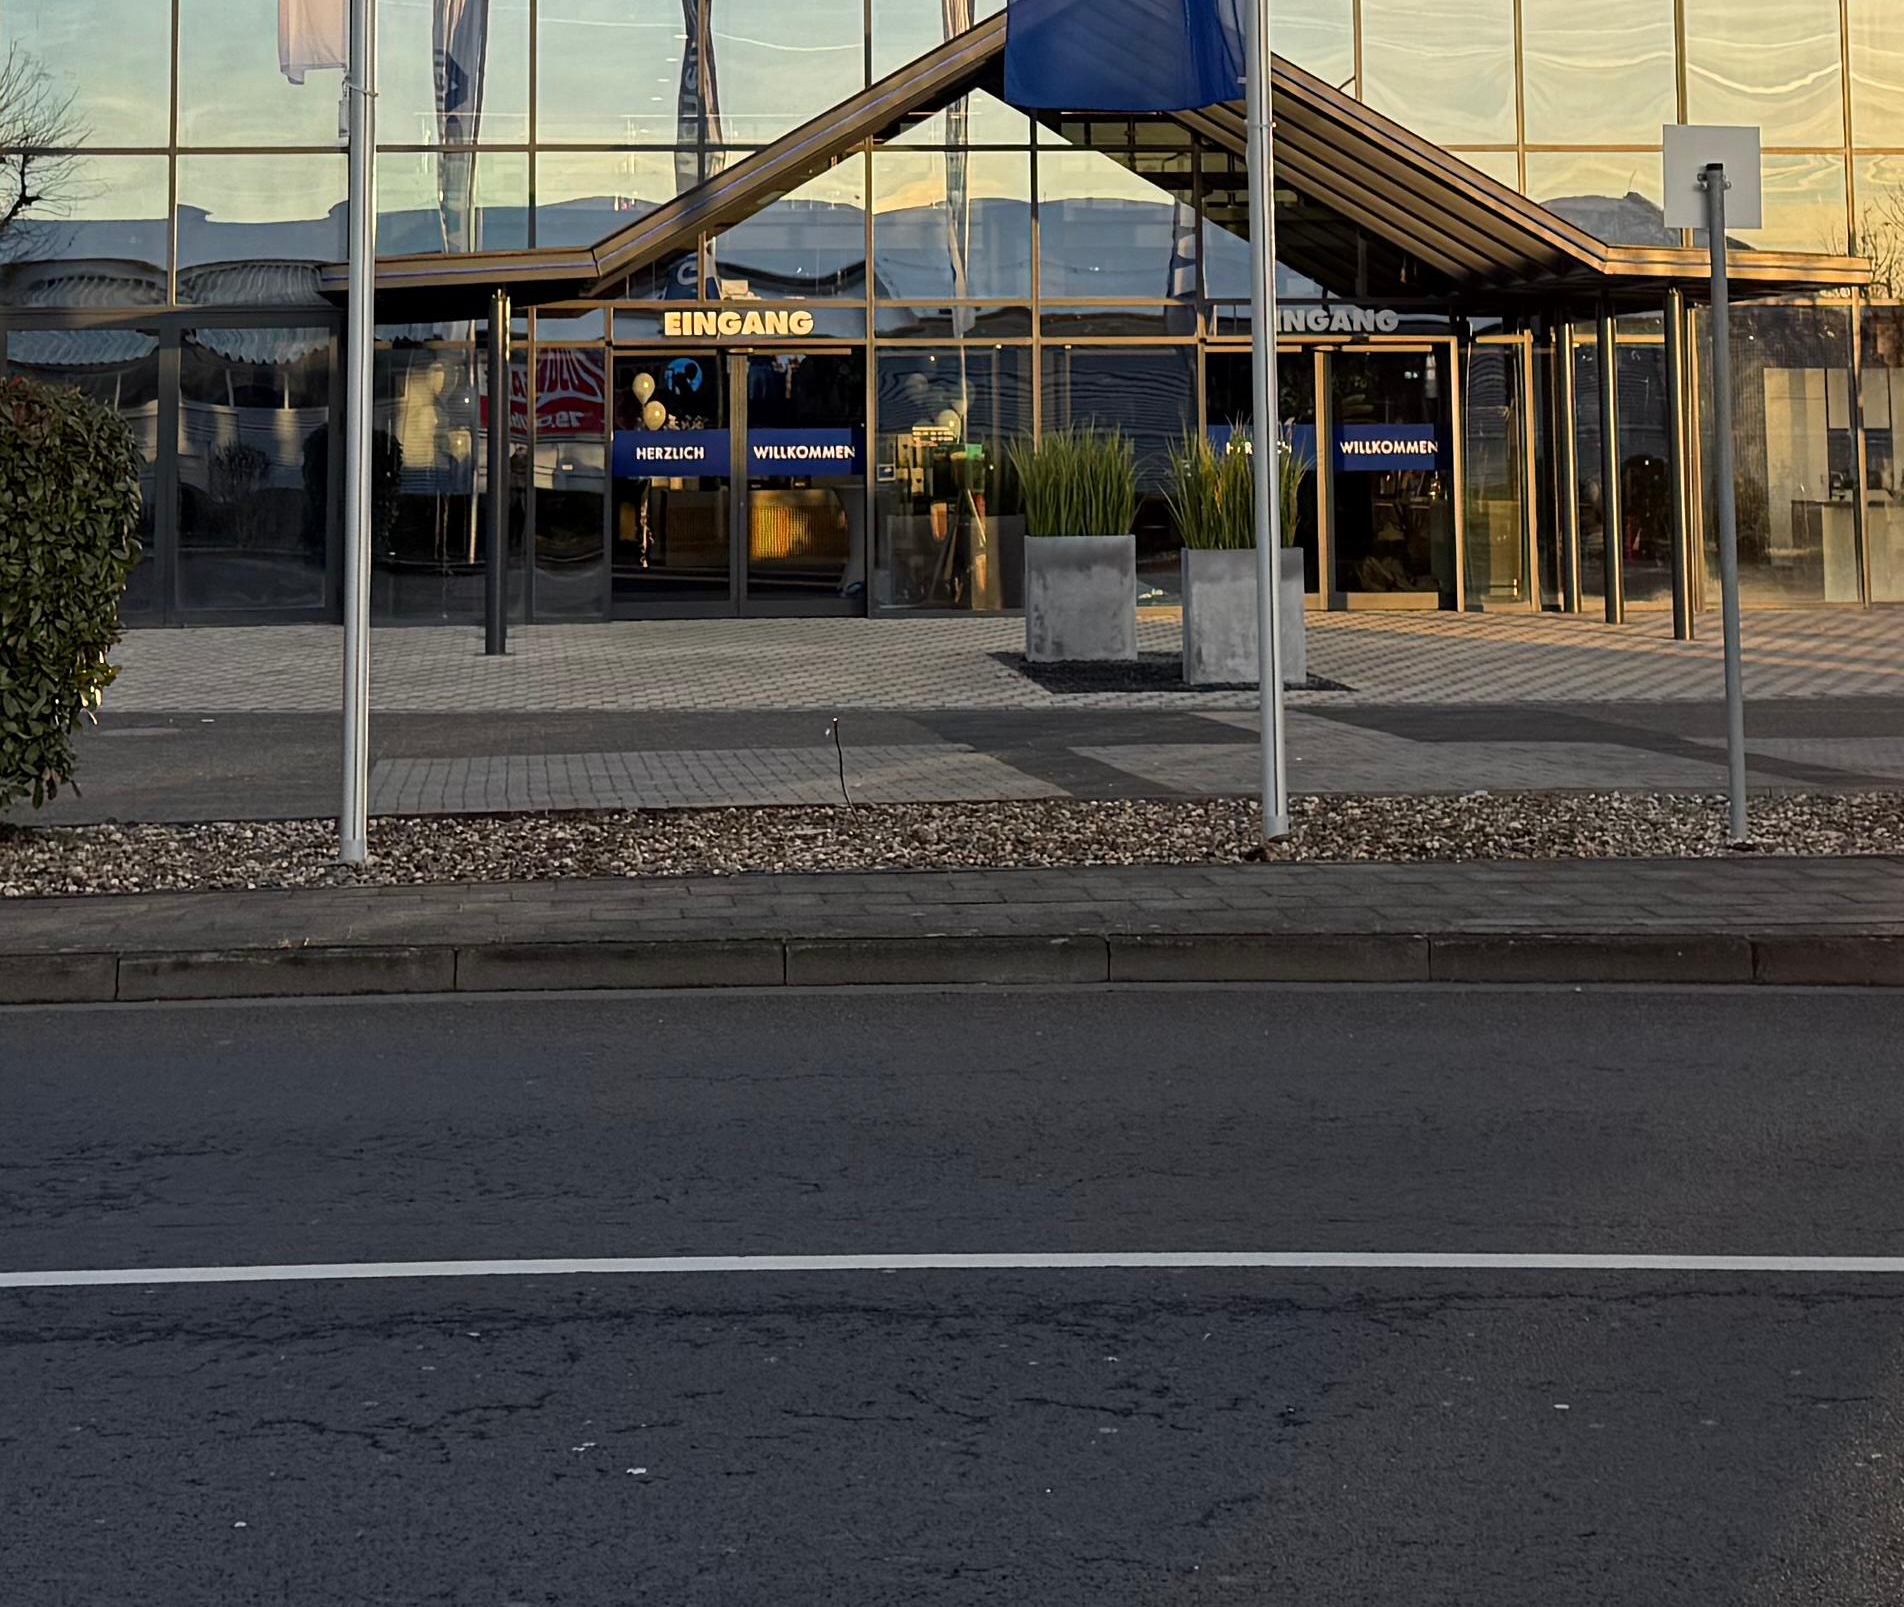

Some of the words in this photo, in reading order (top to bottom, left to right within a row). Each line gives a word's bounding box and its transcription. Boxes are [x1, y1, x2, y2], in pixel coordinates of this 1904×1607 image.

[663, 311, 814, 336] EINGANG
[1276, 308, 1399, 332] INGANG
[634, 446, 705, 461] HERZLICH
[753, 445, 856, 460] WILLKOMMEN
[1339, 441, 1439, 455] WILLKOMMEN
